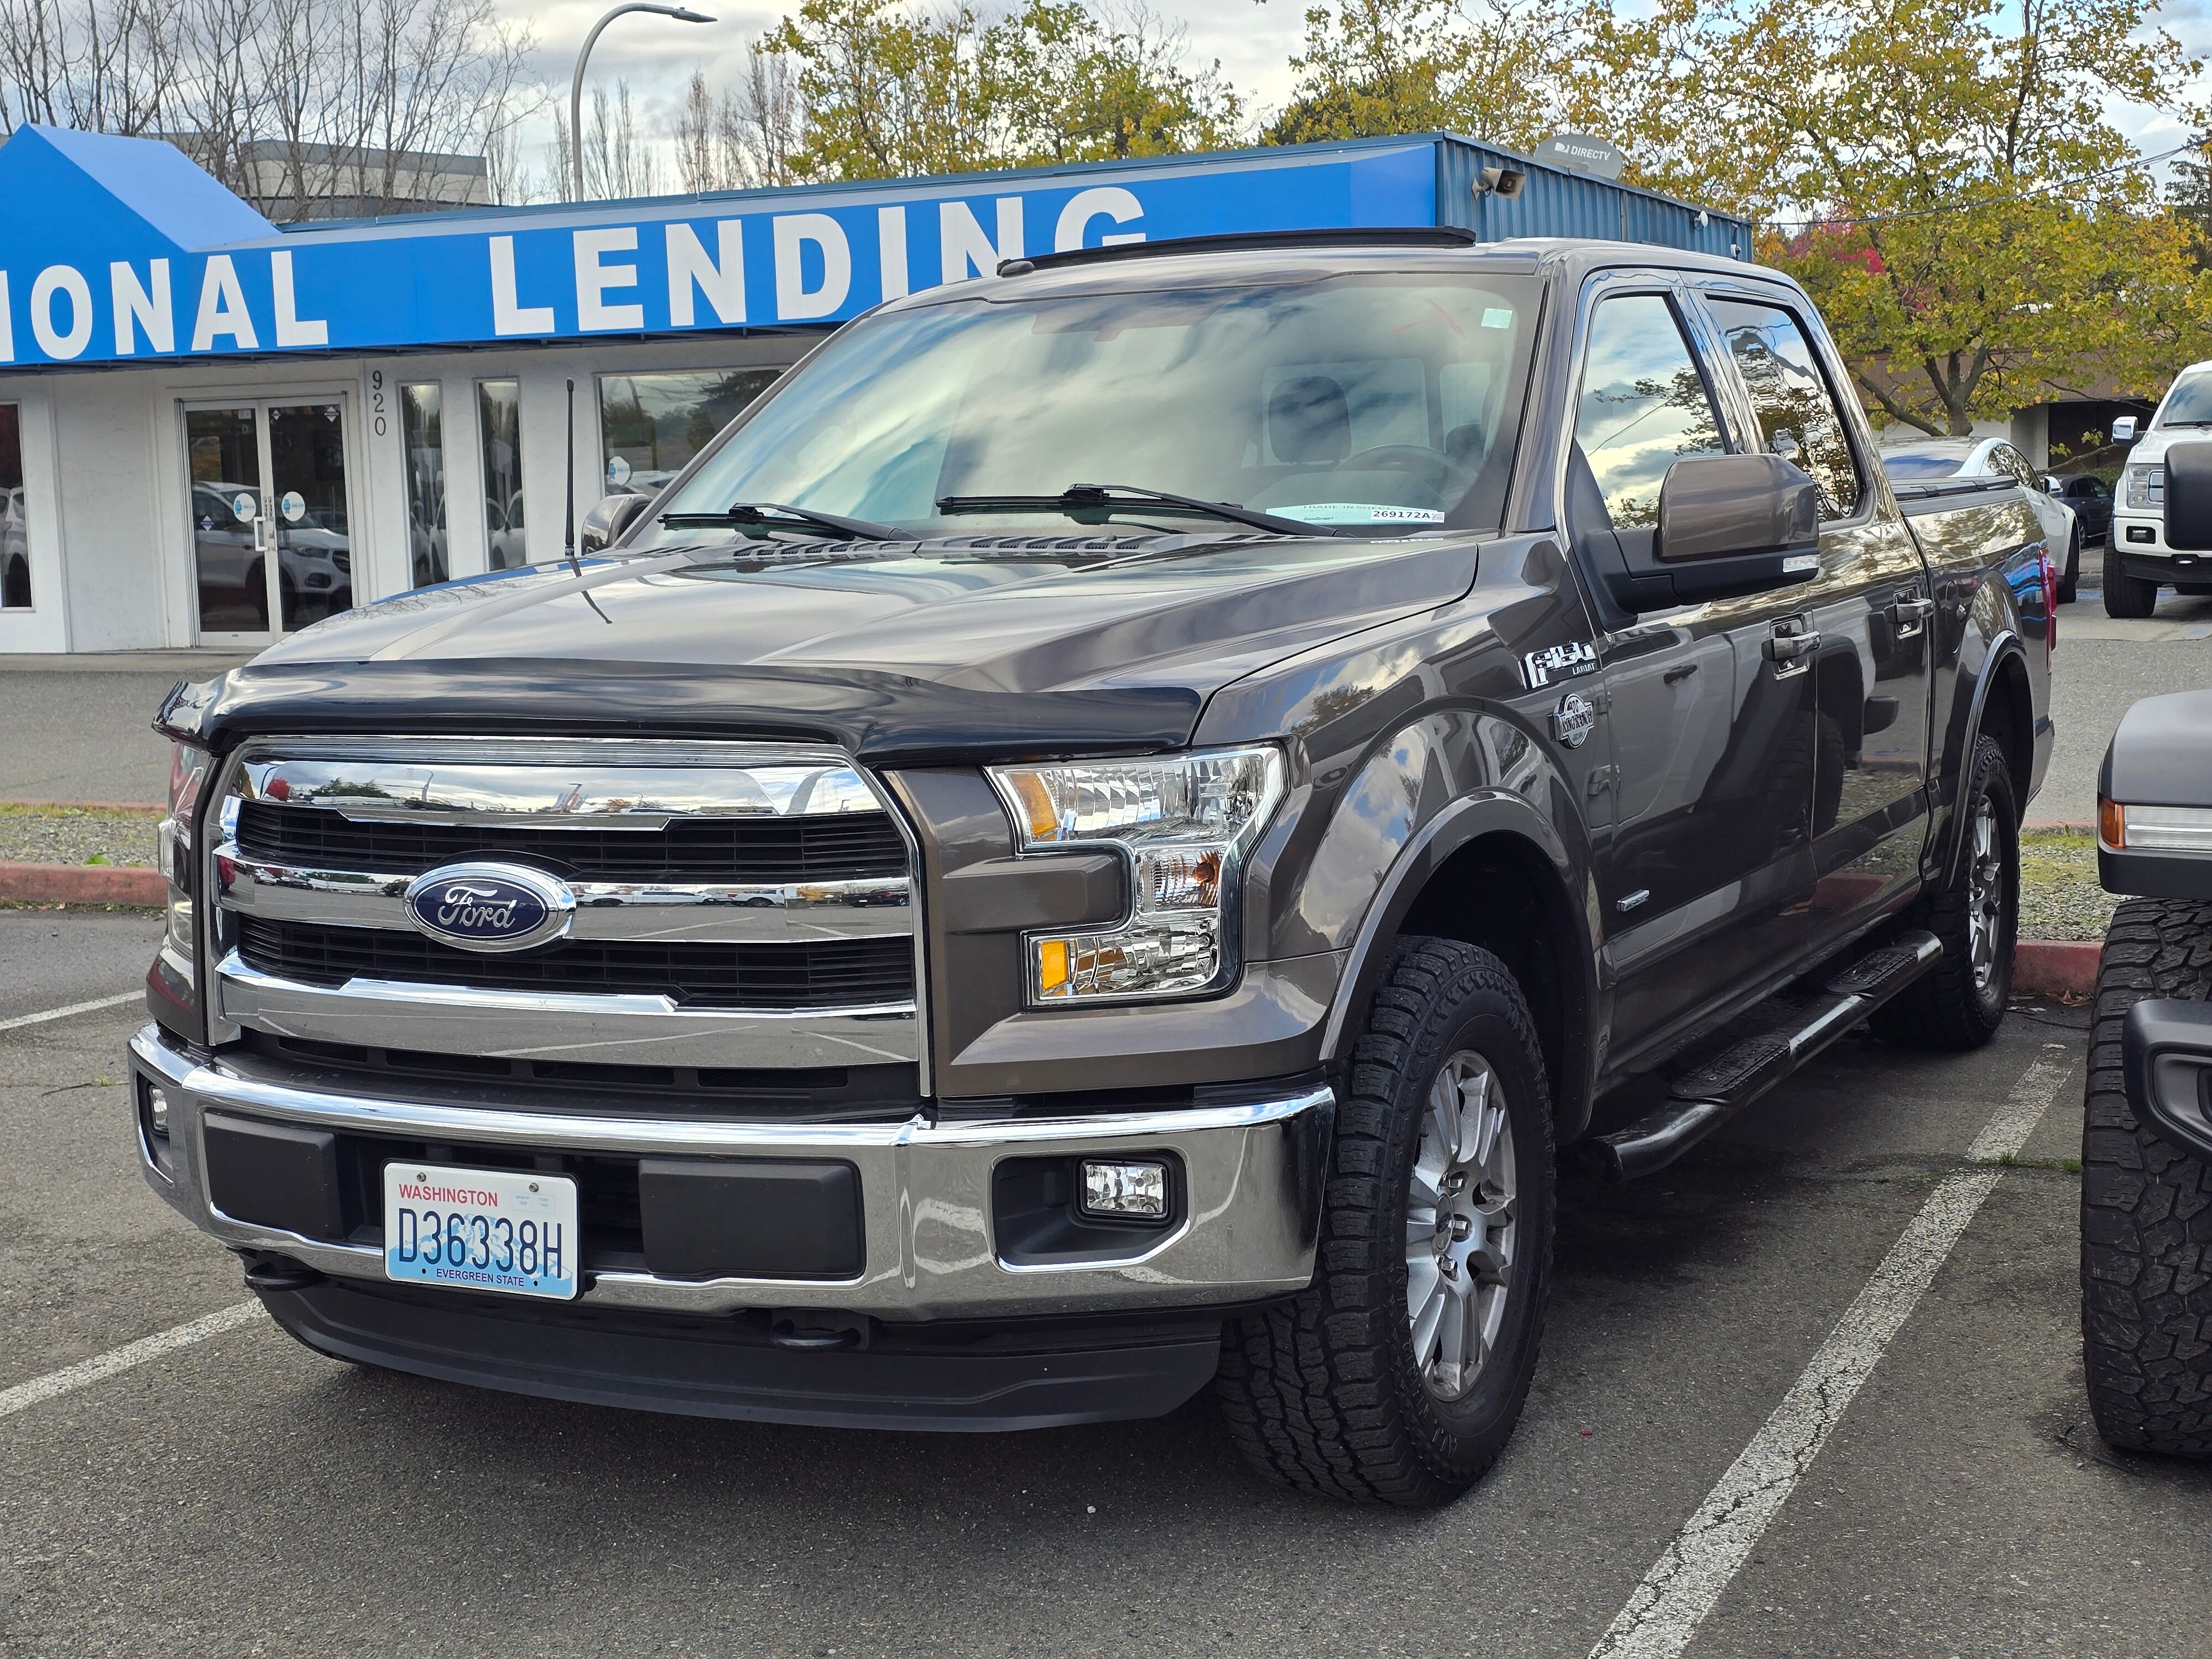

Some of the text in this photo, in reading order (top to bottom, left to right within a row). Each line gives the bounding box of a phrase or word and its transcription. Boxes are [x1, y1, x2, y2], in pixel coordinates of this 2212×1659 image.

[1571, 145, 1610, 161] DIRECTV
[489, 187, 1146, 336] LENDING
[372, 370, 386, 436] 920
[1373, 510, 1430, 519] 269172A
[437, 886, 517, 928] Ford
[399, 1184, 498, 1207] WASHINGTON
[399, 1208, 562, 1279] D36338H
[436, 1269, 524, 1287] EVERGREEN STATE
